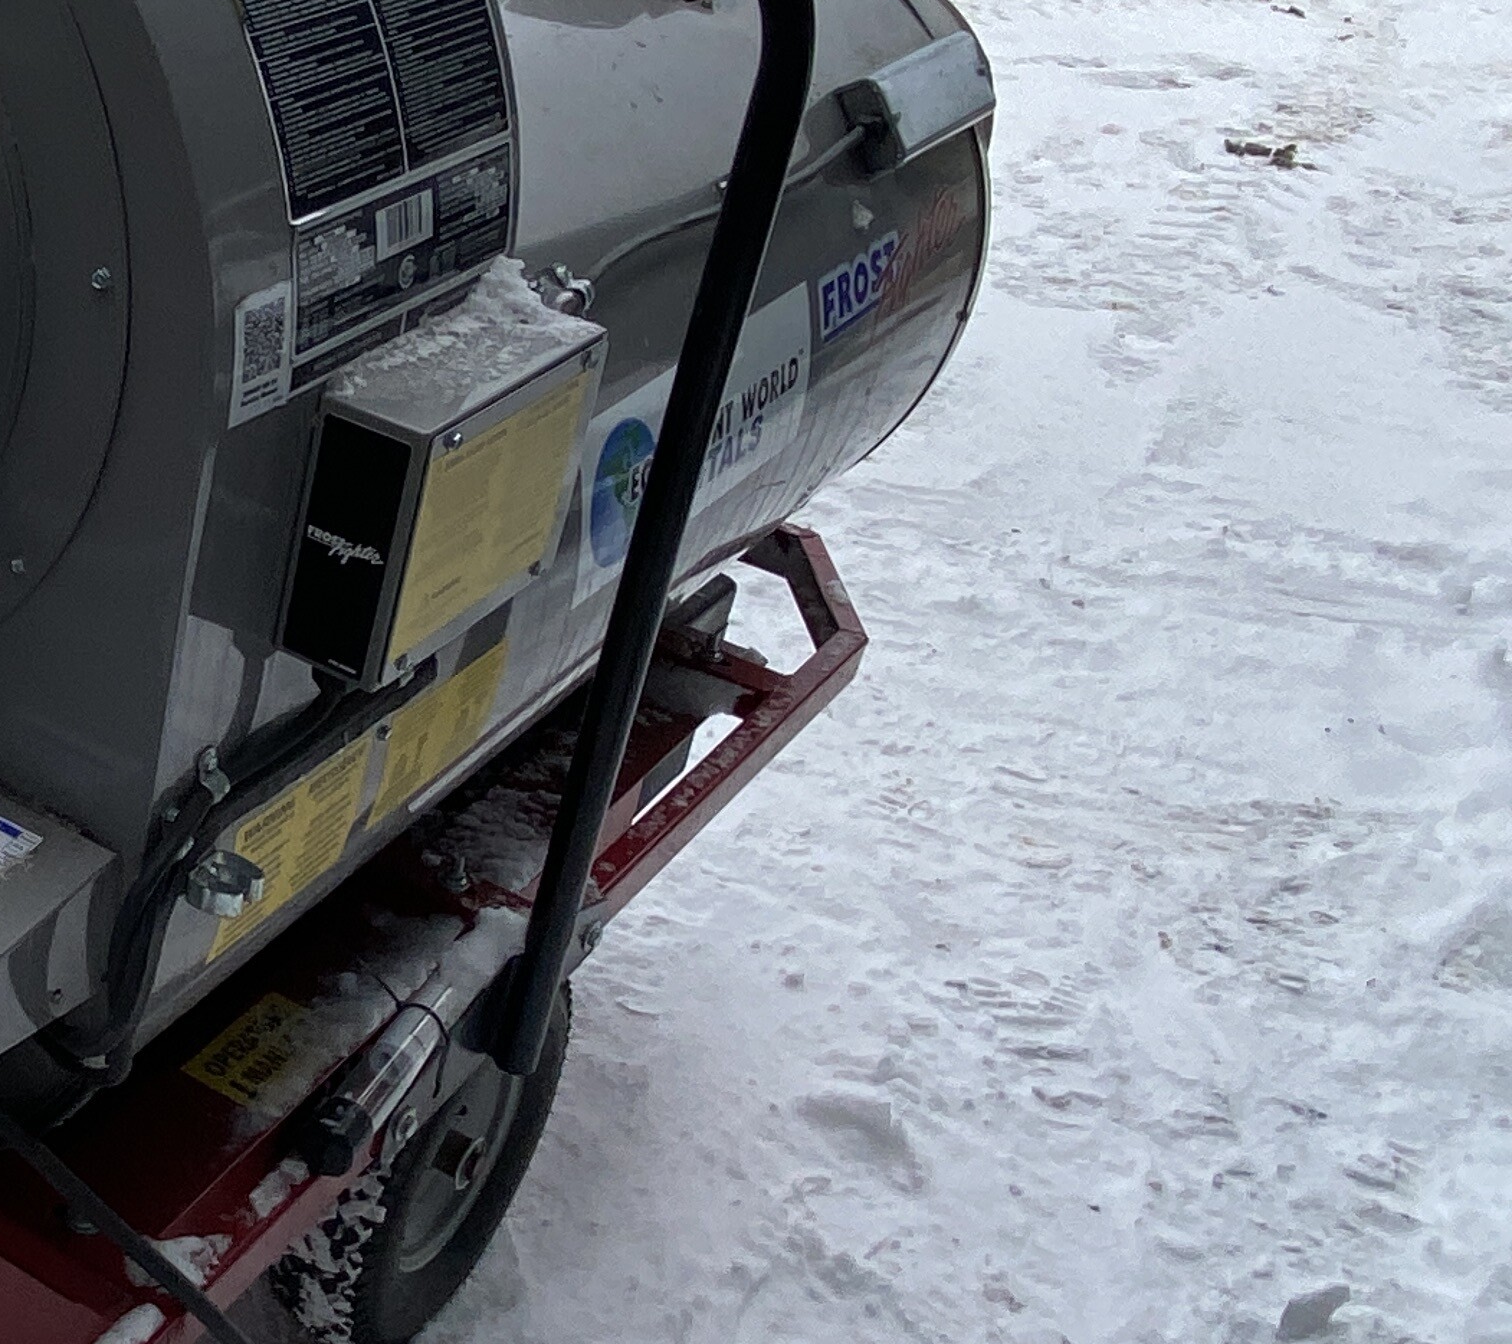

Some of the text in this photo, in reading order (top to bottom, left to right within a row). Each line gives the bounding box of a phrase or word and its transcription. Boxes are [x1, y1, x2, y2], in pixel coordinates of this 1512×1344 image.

[821, 238, 897, 331] FROST
[741, 357, 799, 421] WORLD
[707, 413, 764, 483] TALS
